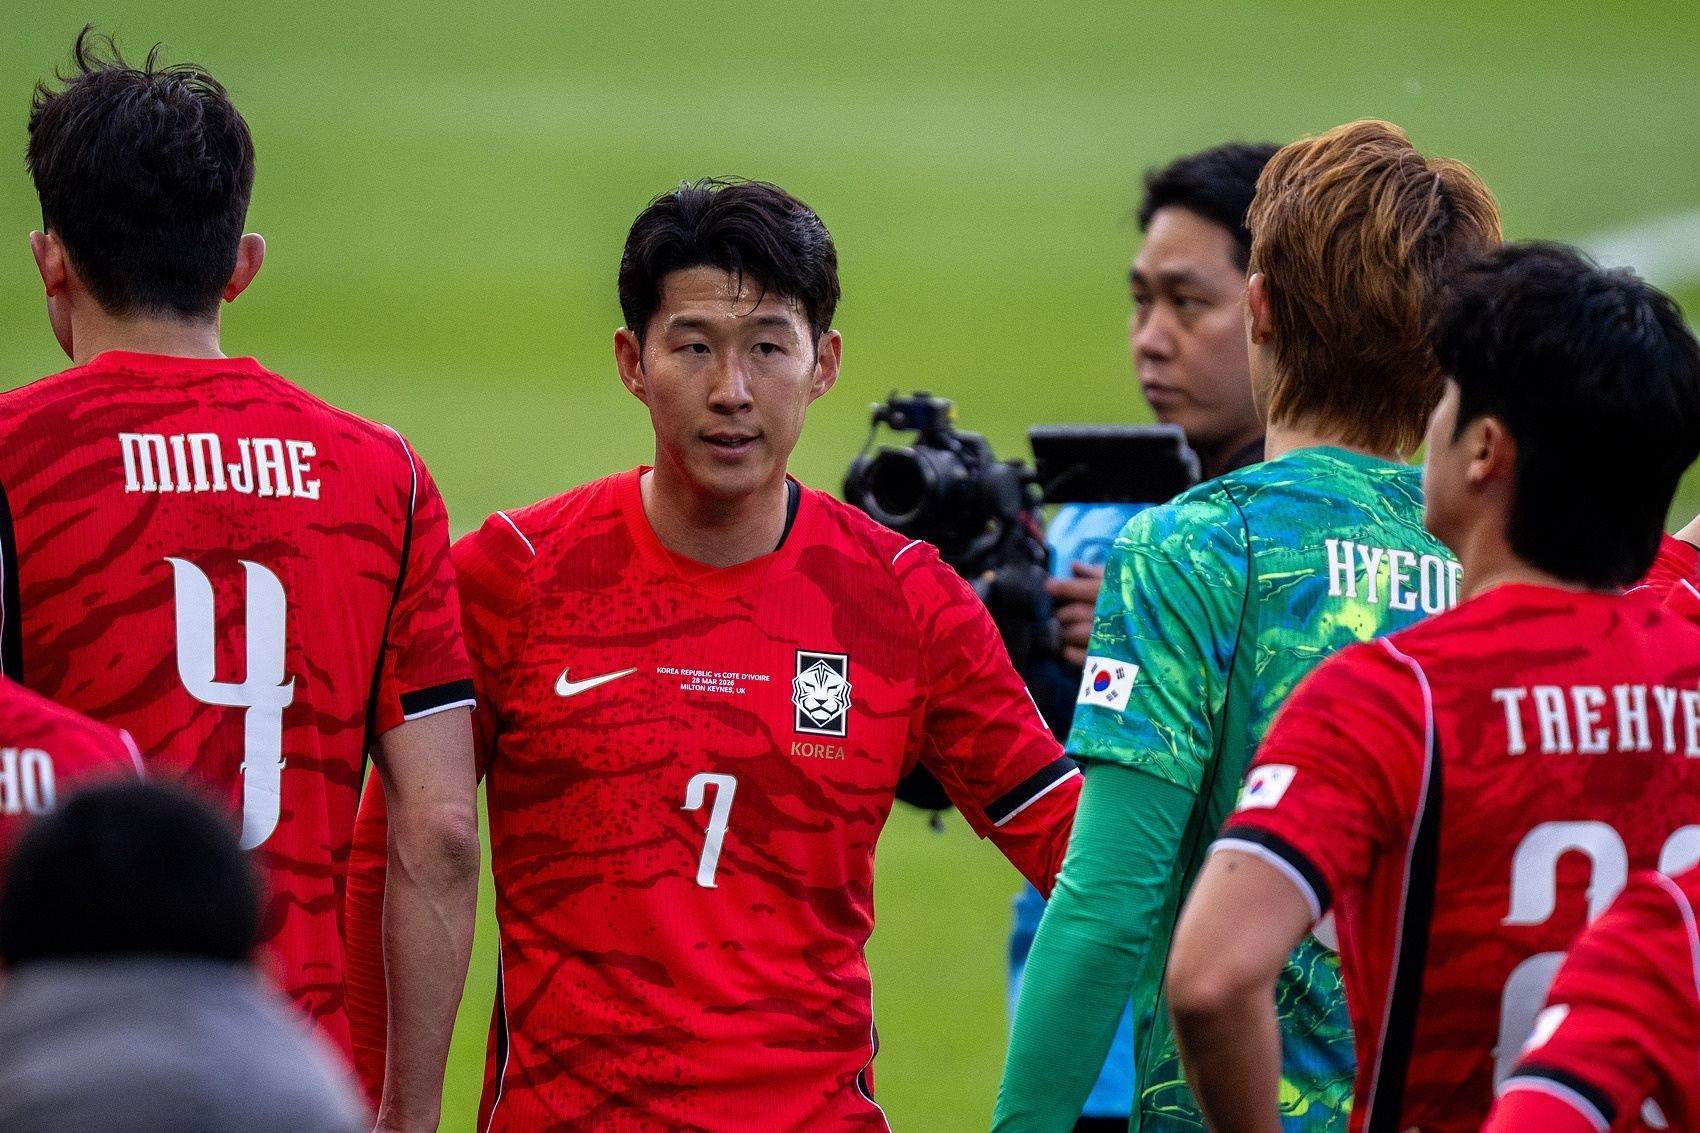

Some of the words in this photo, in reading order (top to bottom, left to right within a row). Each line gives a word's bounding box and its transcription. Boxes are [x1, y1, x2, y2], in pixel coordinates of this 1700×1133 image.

[118, 432, 321, 500] MINJAE
[656, 667, 679, 675] KOREA
[681, 668, 713, 677] REPUBLIC
[741, 673, 770, 682] D'IVOIRE
[680, 683, 706, 692] MILTON
[707, 685, 734, 694] KEYNES,
[164, 557, 296, 851] 4
[790, 741, 845, 761] KOREA
[680, 773, 737, 888] 7
